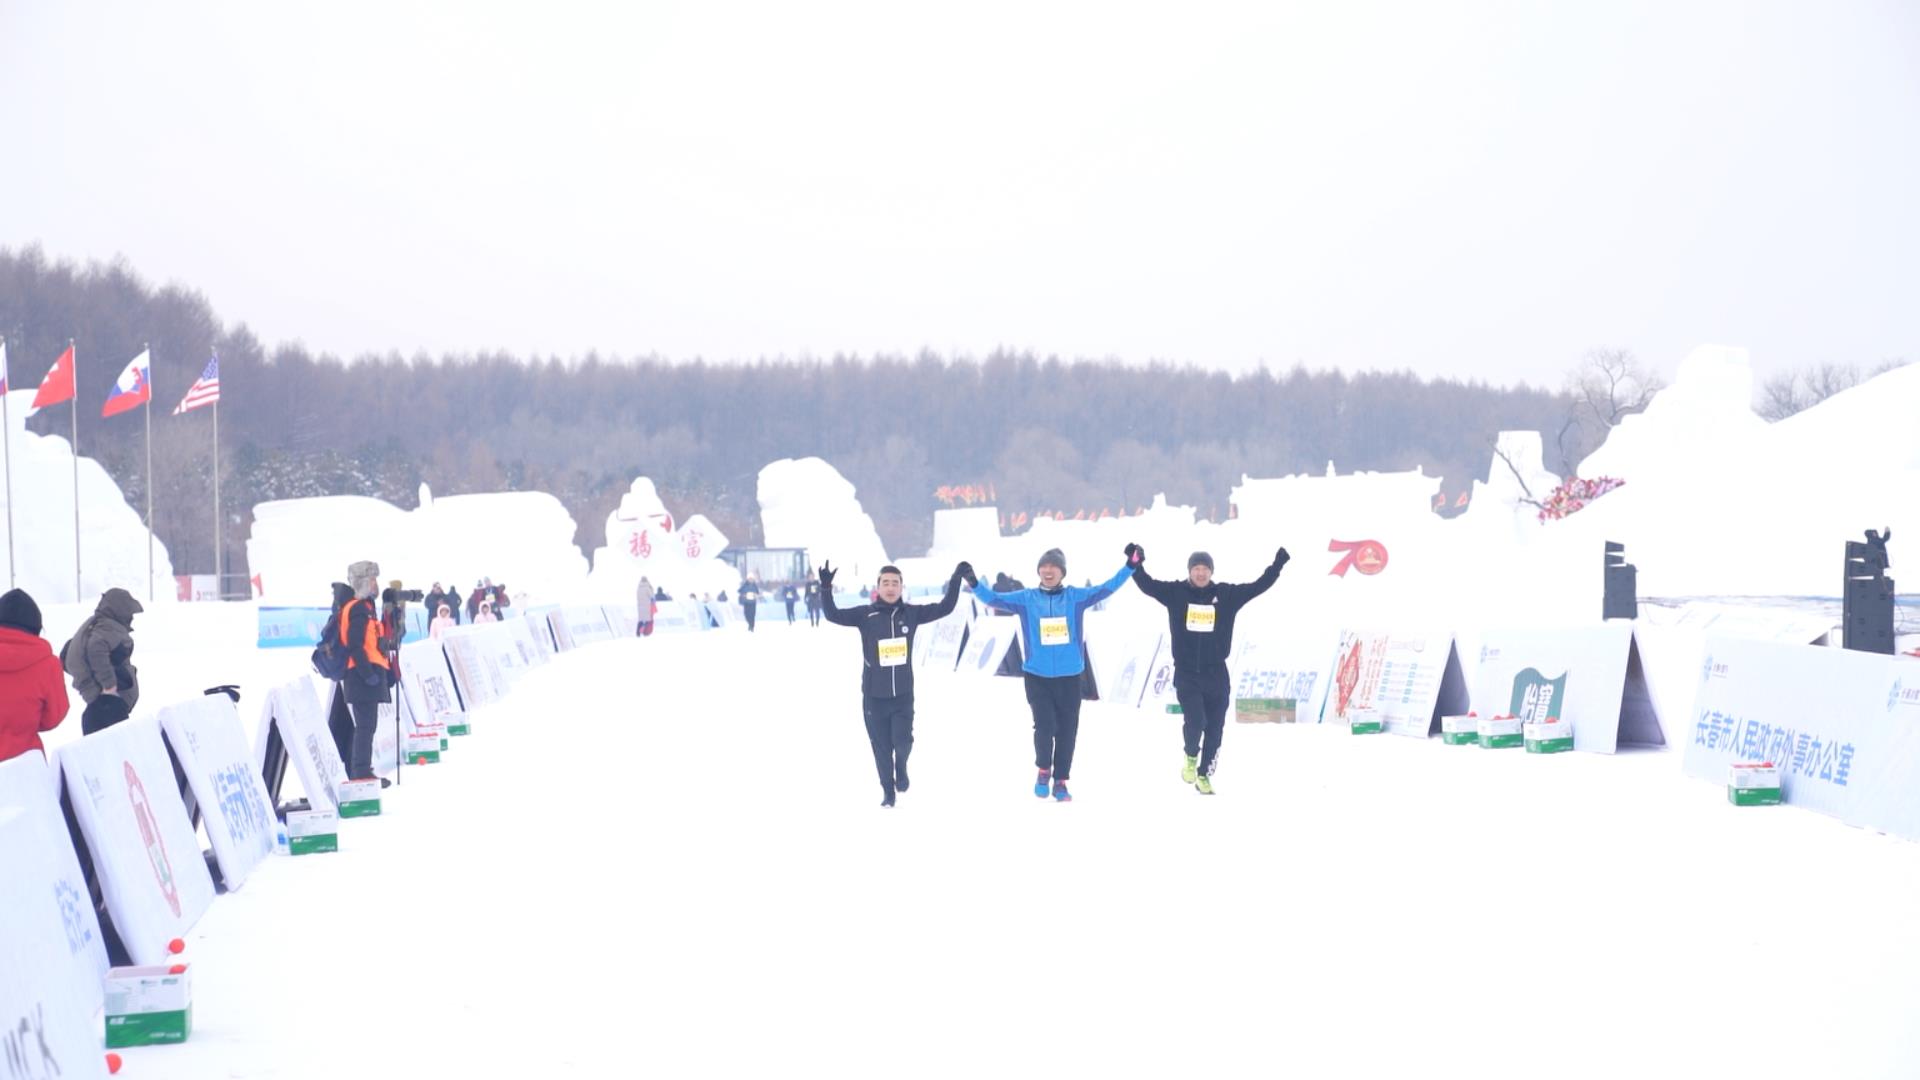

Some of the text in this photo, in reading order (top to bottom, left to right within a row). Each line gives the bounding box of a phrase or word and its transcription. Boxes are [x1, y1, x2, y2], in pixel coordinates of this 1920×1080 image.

[629, 529, 652, 559] 福
[681, 529, 704, 559] 富
[1328, 538, 1389, 579] 70
[1695, 706, 1855, 787] 长春市人民政府外事办公室
